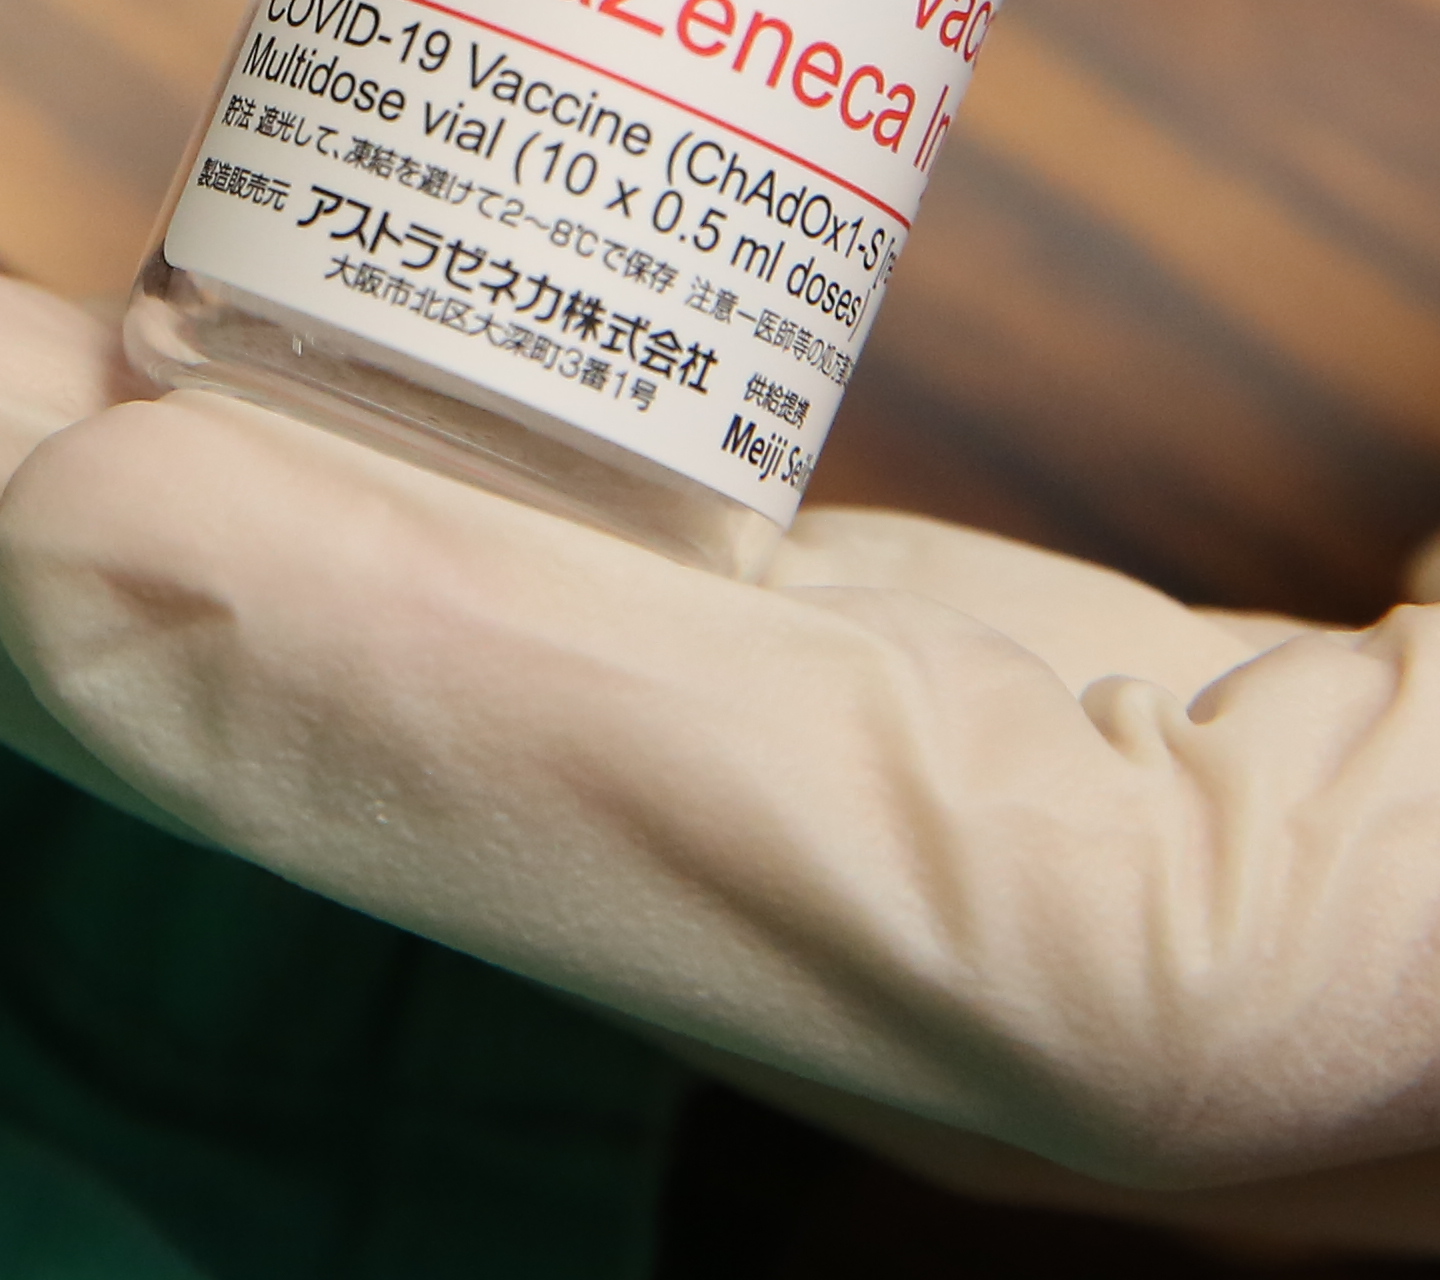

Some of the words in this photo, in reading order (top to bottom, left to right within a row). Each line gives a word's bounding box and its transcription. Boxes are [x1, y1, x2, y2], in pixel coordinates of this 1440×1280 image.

[242, 32, 406, 122] Multidose
[422, 101, 506, 160] vial
[513, 130, 598, 196] (10
[605, 178, 641, 219] x
[651, 189, 728, 253] 0.5
[730, 233, 787, 284] ml
[785, 256, 871, 343] doses)
[470, 42, 653, 157] Vaccine
[666, 130, 886, 272] (ChAdOx1-S
[196, 157, 292, 213] 製造販売元
[296, 184, 719, 395] アストラゼネカ株式会社
[720, 413, 789, 482] Meiji
